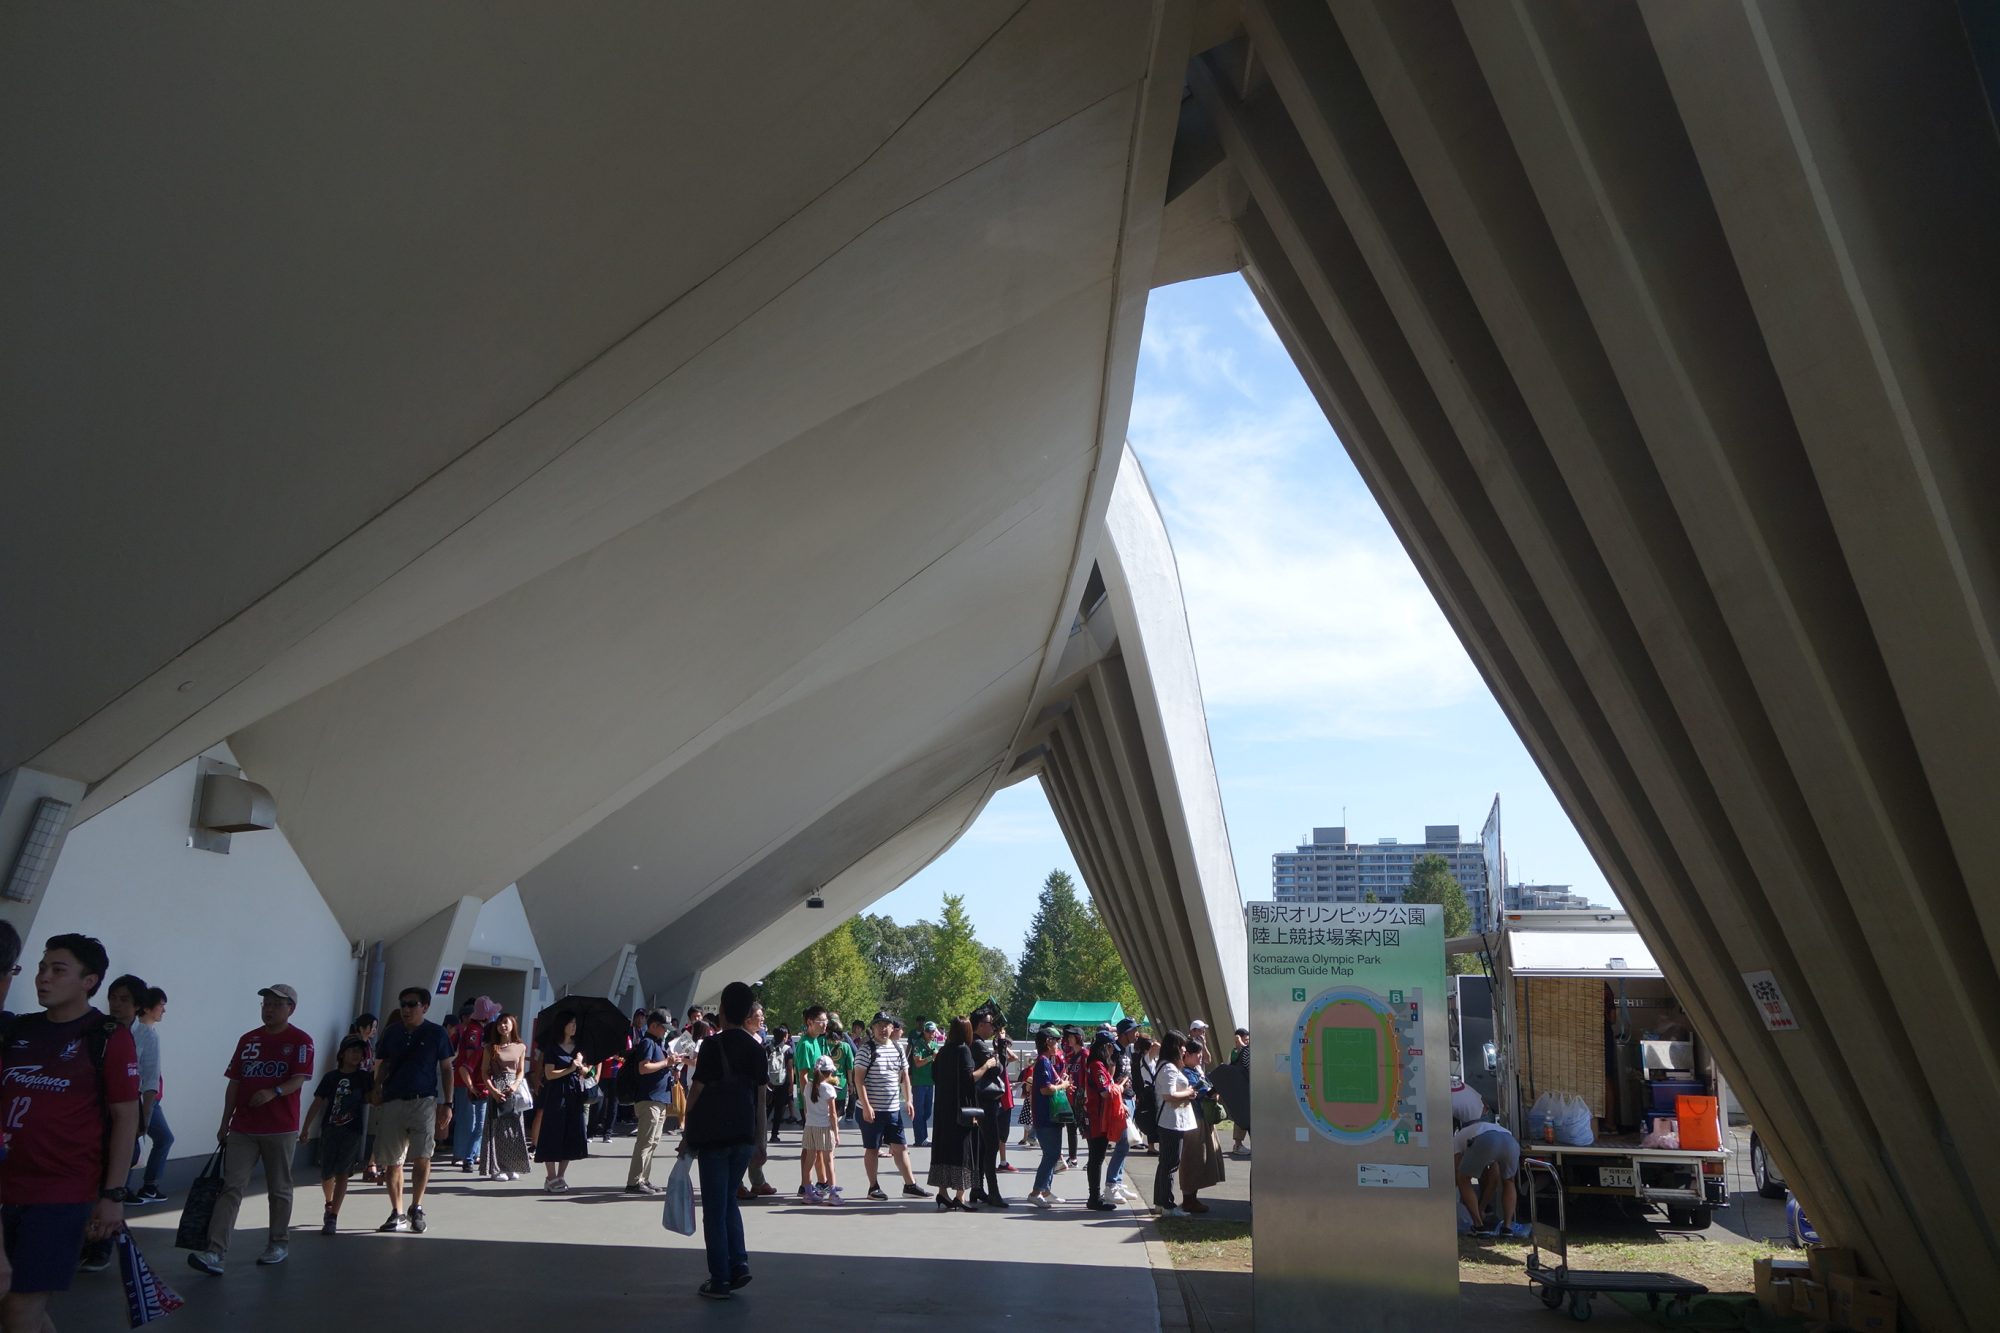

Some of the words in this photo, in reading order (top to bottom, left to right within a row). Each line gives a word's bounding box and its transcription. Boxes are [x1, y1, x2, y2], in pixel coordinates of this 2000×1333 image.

[1252, 905, 1425, 926] 駒沢オリンピック公園
[1252, 928, 1400, 947] 陸上競技場案内図
[1253, 954, 1310, 964] Komazawa
[1312, 954, 1355, 965] Olympic
[1357, 955, 1381, 965] Park
[1253, 966, 1295, 975] Stadium
[1298, 966, 1328, 976] Guide
[1331, 966, 1354, 977] Map
[1295, 991, 1304, 1001] C
[1392, 993, 1401, 1004] B
[241, 1043, 261, 1060] 25
[2, 1065, 71, 1088] Fagiano
[7, 1096, 32, 1128] 12
[1397, 1133, 1406, 1143] A
[1609, 1175, 1633, 1185] 31-4
